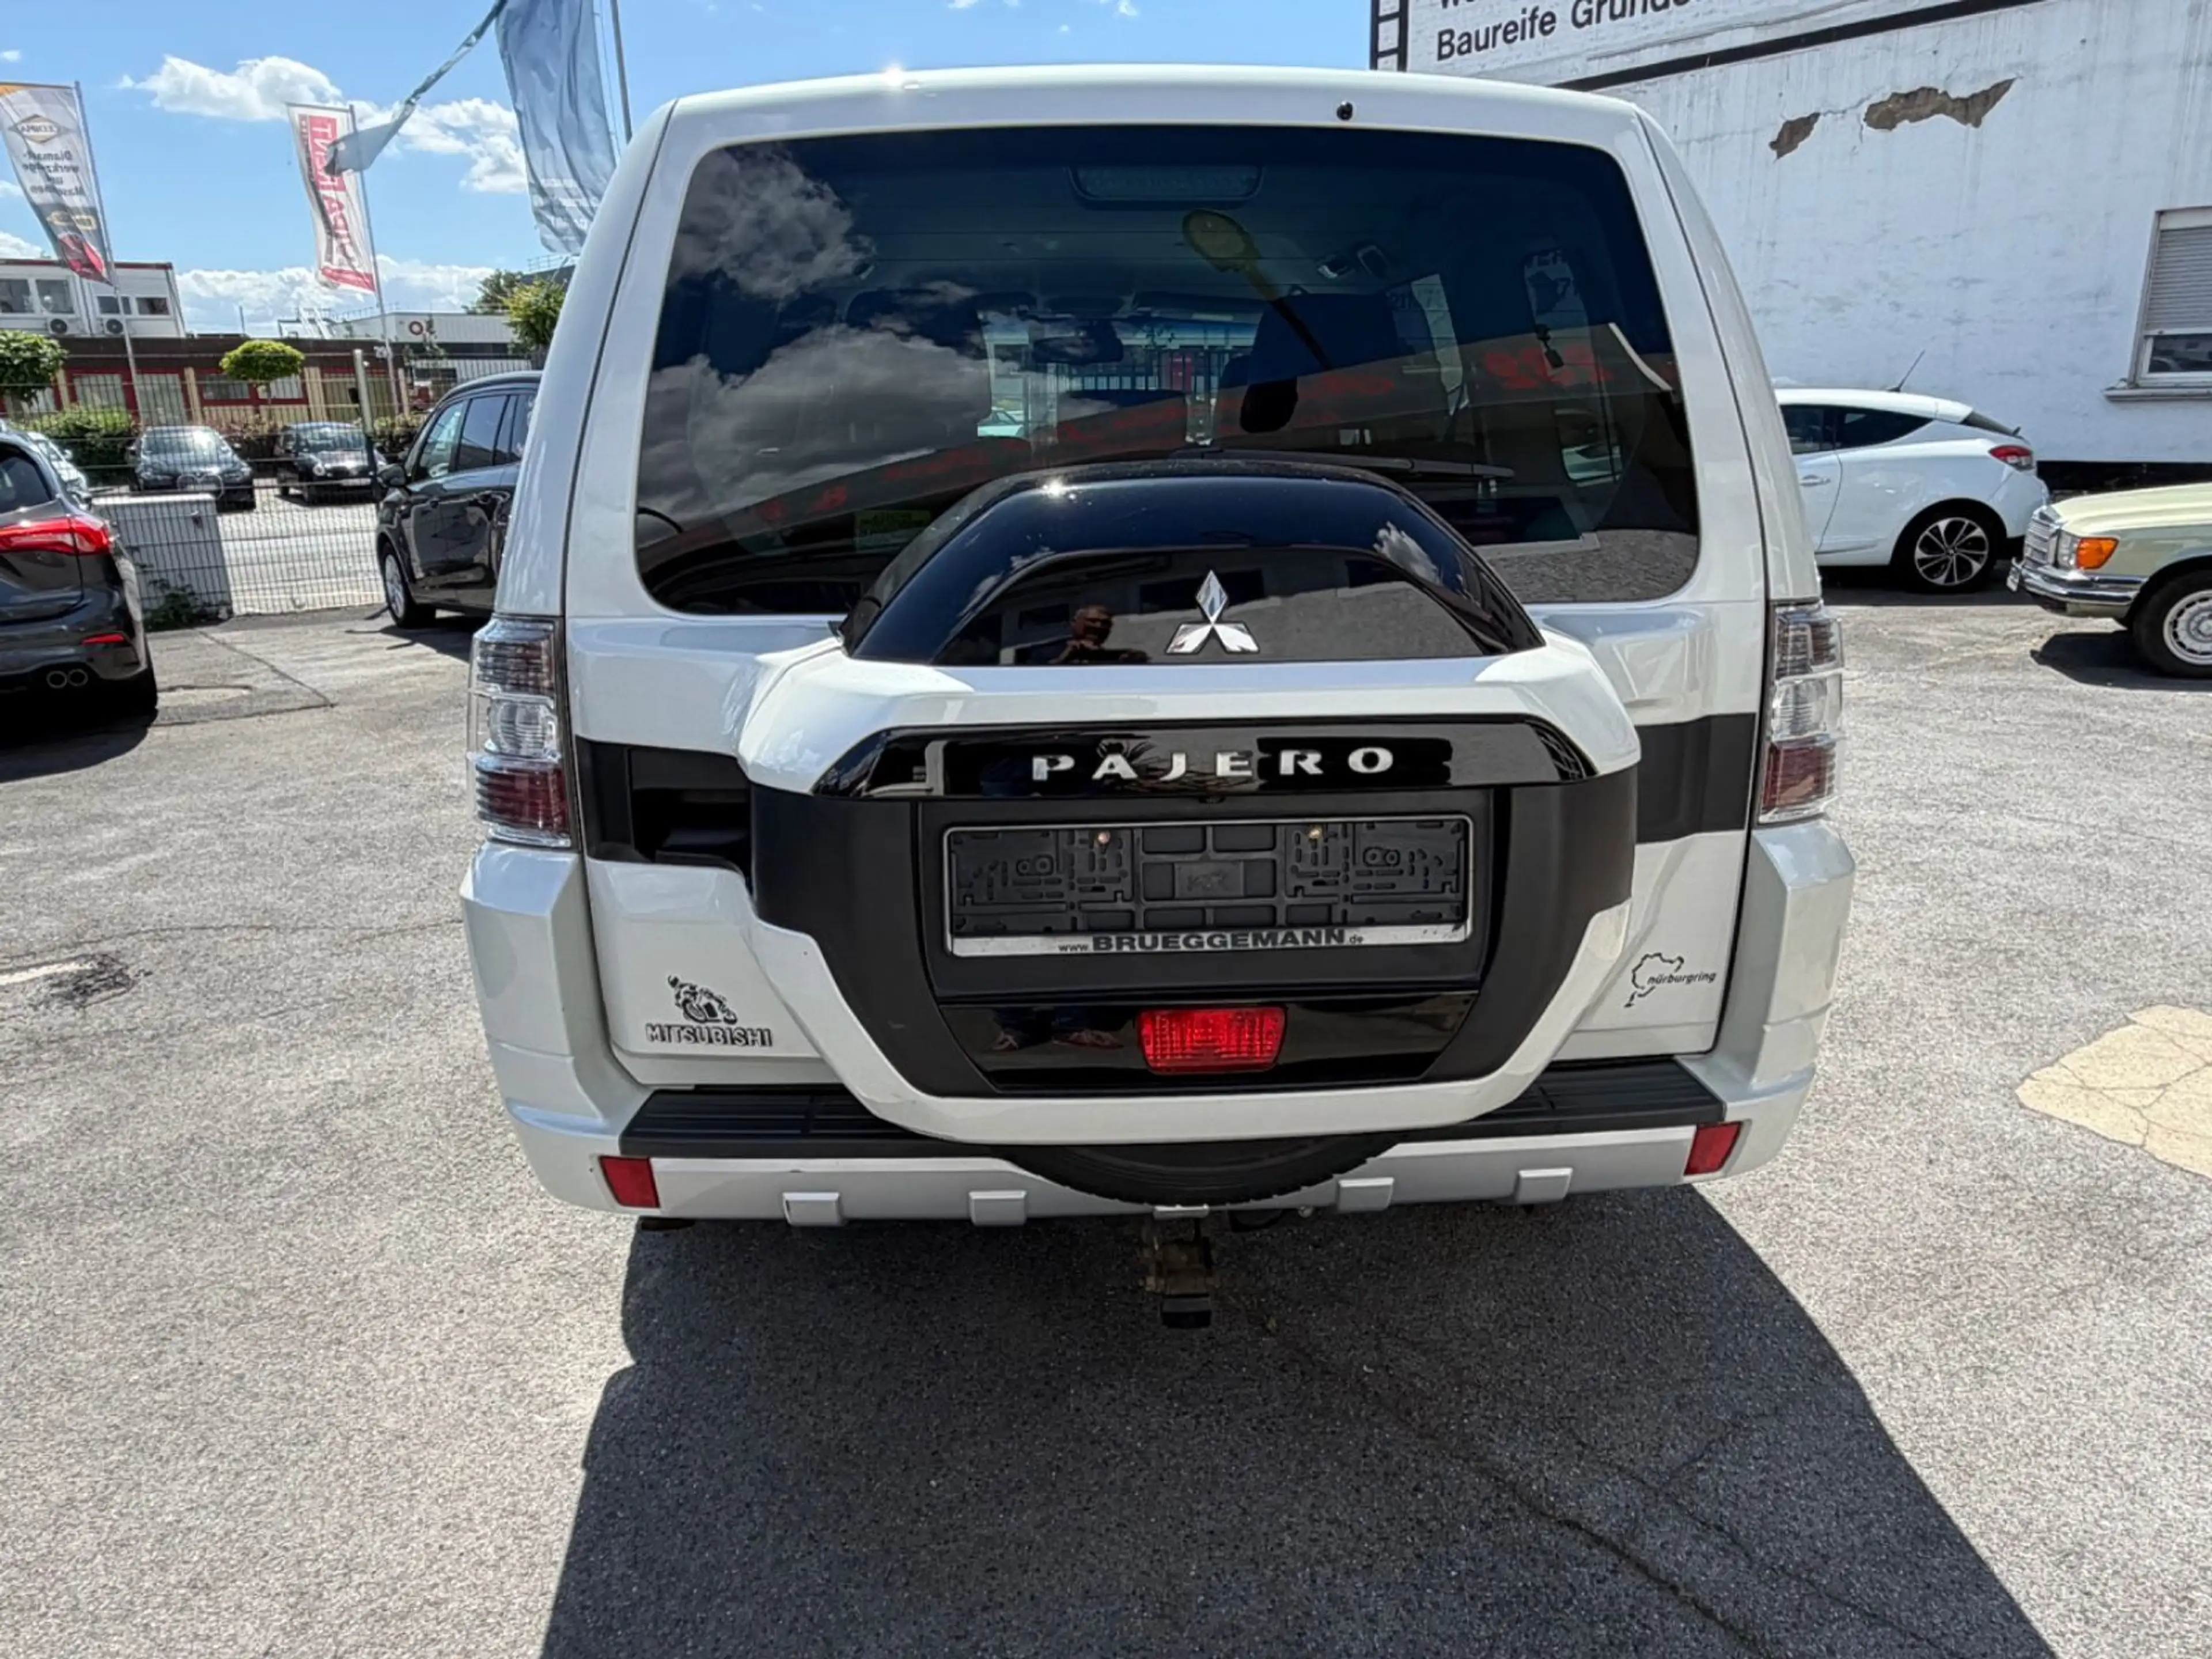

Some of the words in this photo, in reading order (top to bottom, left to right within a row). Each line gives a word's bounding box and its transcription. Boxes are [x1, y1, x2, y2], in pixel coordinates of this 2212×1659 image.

[1437, 5, 1557, 61] Baureife
[1571, 0, 1691, 29] Grun
[1032, 747, 1395, 782] PAJERO
[1647, 971, 1717, 985] nürburgring
[645, 1022, 774, 1047] MITSUBISHI
